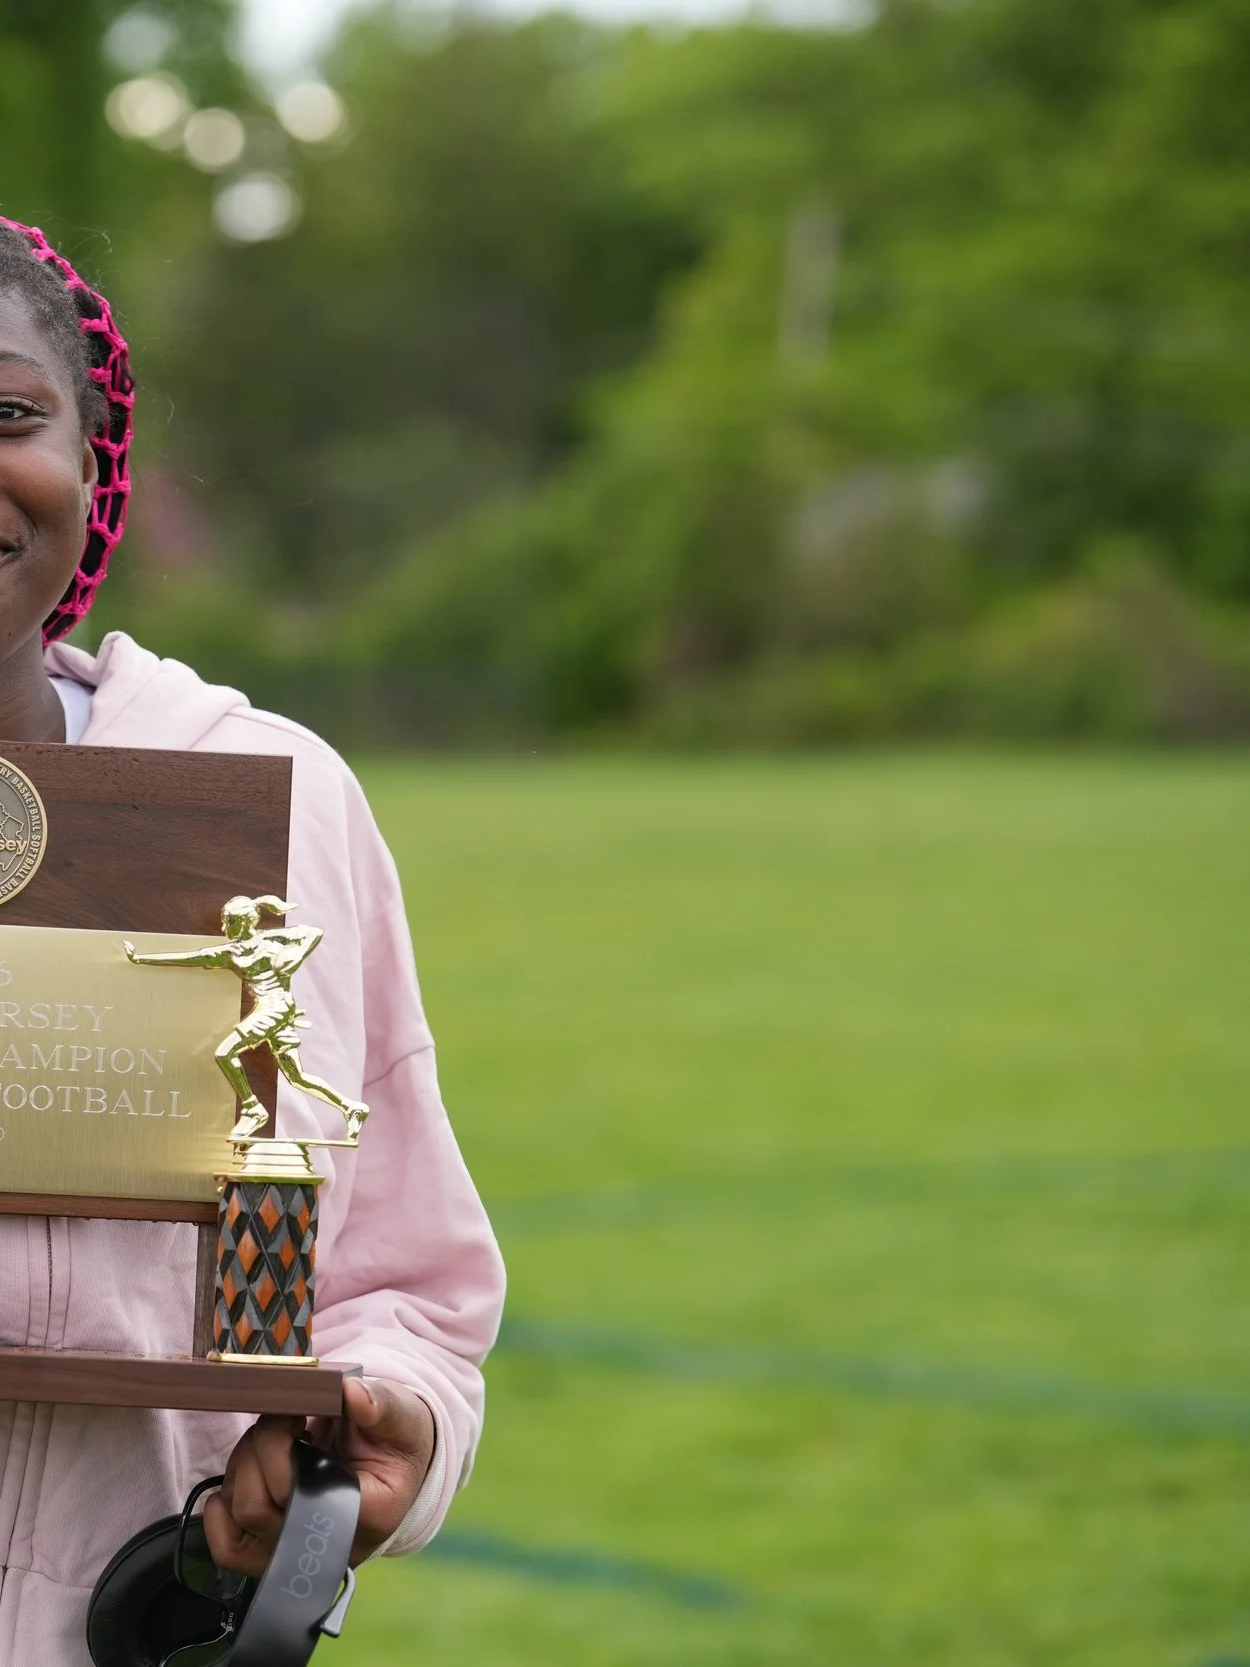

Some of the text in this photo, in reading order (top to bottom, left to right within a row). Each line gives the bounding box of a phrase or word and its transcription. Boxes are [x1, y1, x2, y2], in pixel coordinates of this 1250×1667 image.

[11, 775, 41, 832] BASKETBALL
[15, 834, 42, 879] SOFTBALL
[280, 1512, 335, 1599] beats
